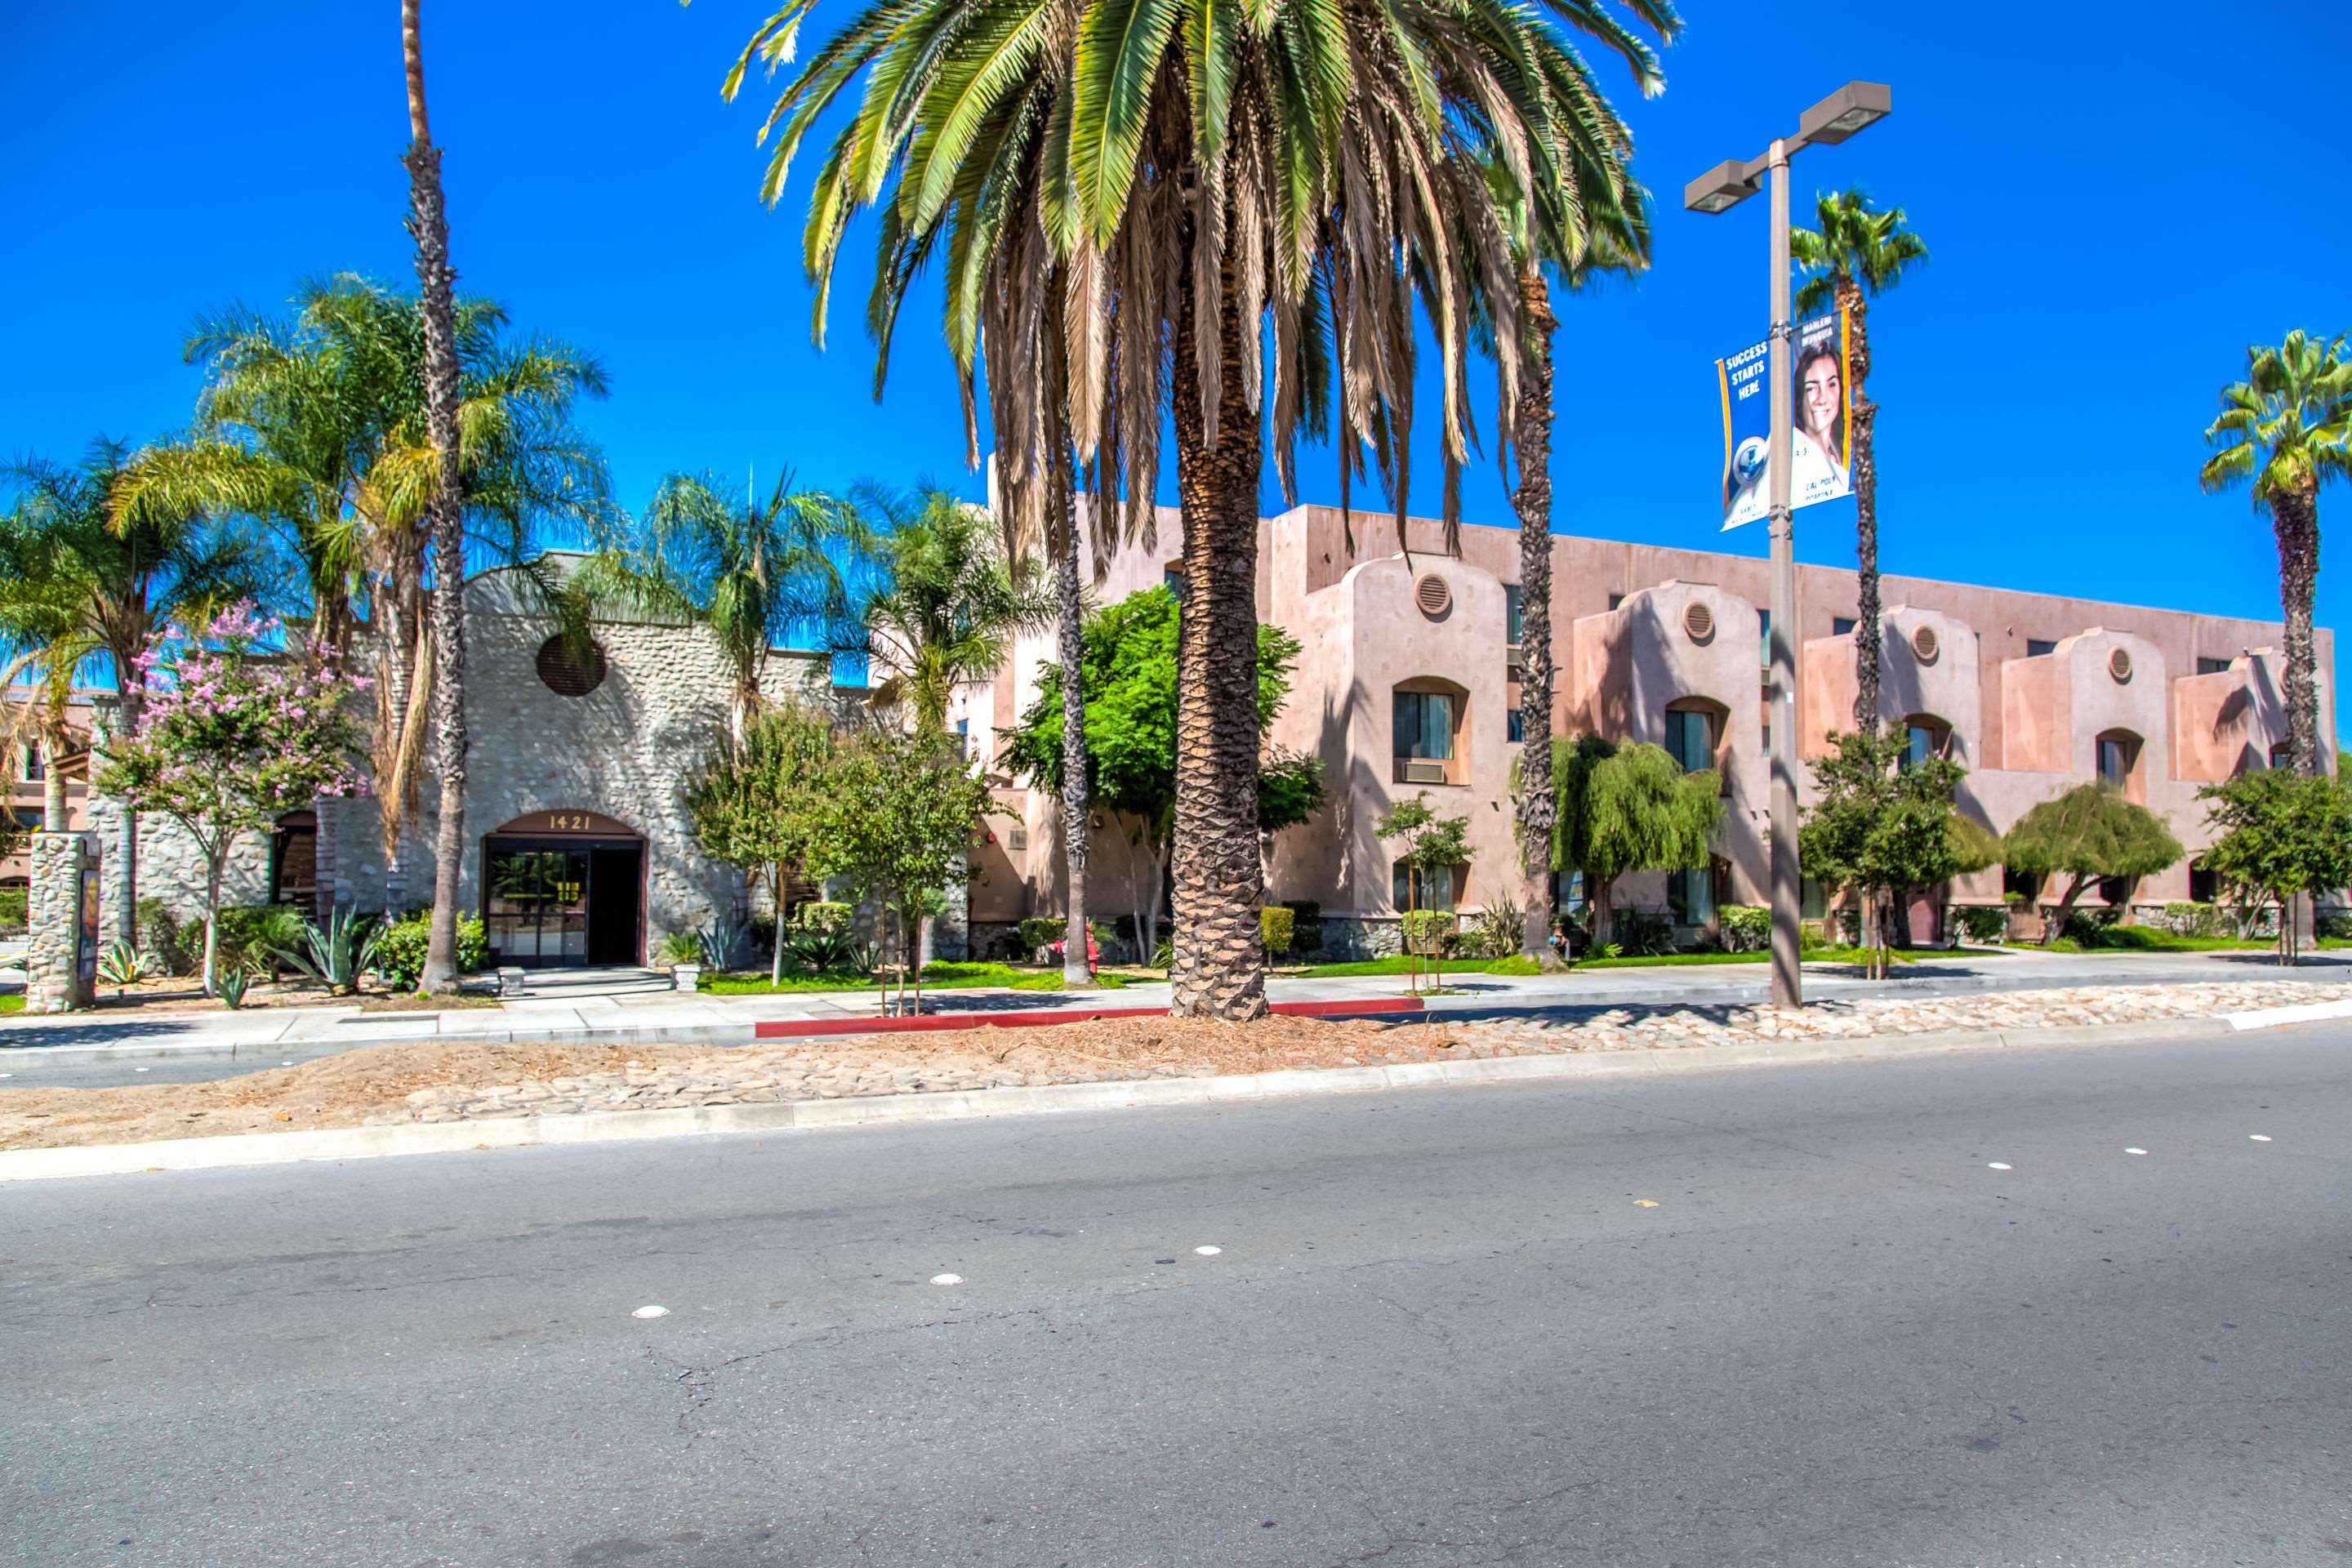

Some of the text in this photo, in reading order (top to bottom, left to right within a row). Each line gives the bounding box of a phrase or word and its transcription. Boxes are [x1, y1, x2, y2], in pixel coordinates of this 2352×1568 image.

[1726, 341, 1767, 370] SUCCESS
[1731, 360, 1764, 385] STARTS
[1738, 380, 1760, 401] HERE
[550, 816, 590, 830] 1421
